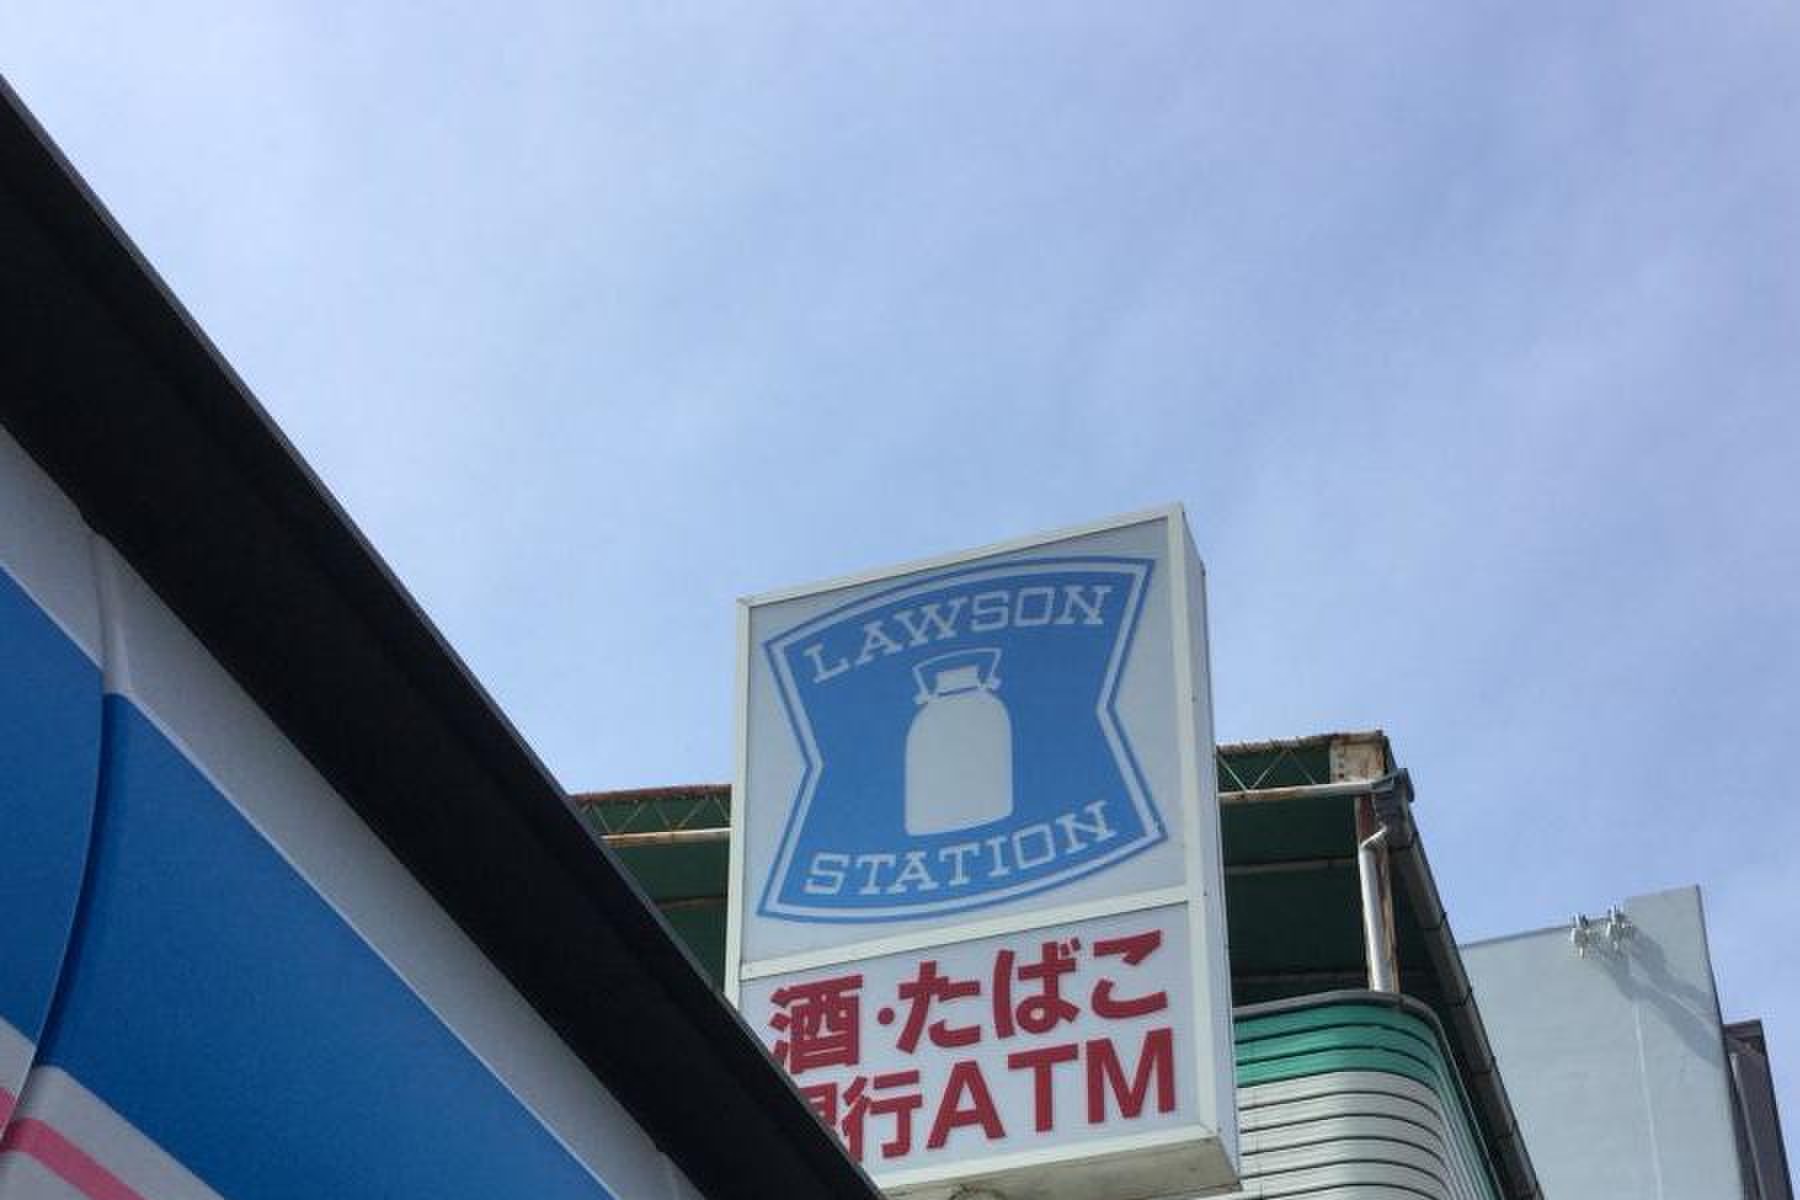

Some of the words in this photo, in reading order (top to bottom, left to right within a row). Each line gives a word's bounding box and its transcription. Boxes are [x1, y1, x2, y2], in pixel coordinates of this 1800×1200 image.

[804, 582, 1114, 684] LAWSON
[805, 800, 1117, 898] STATION
[798, 1027, 1176, 1164] 行ATM
